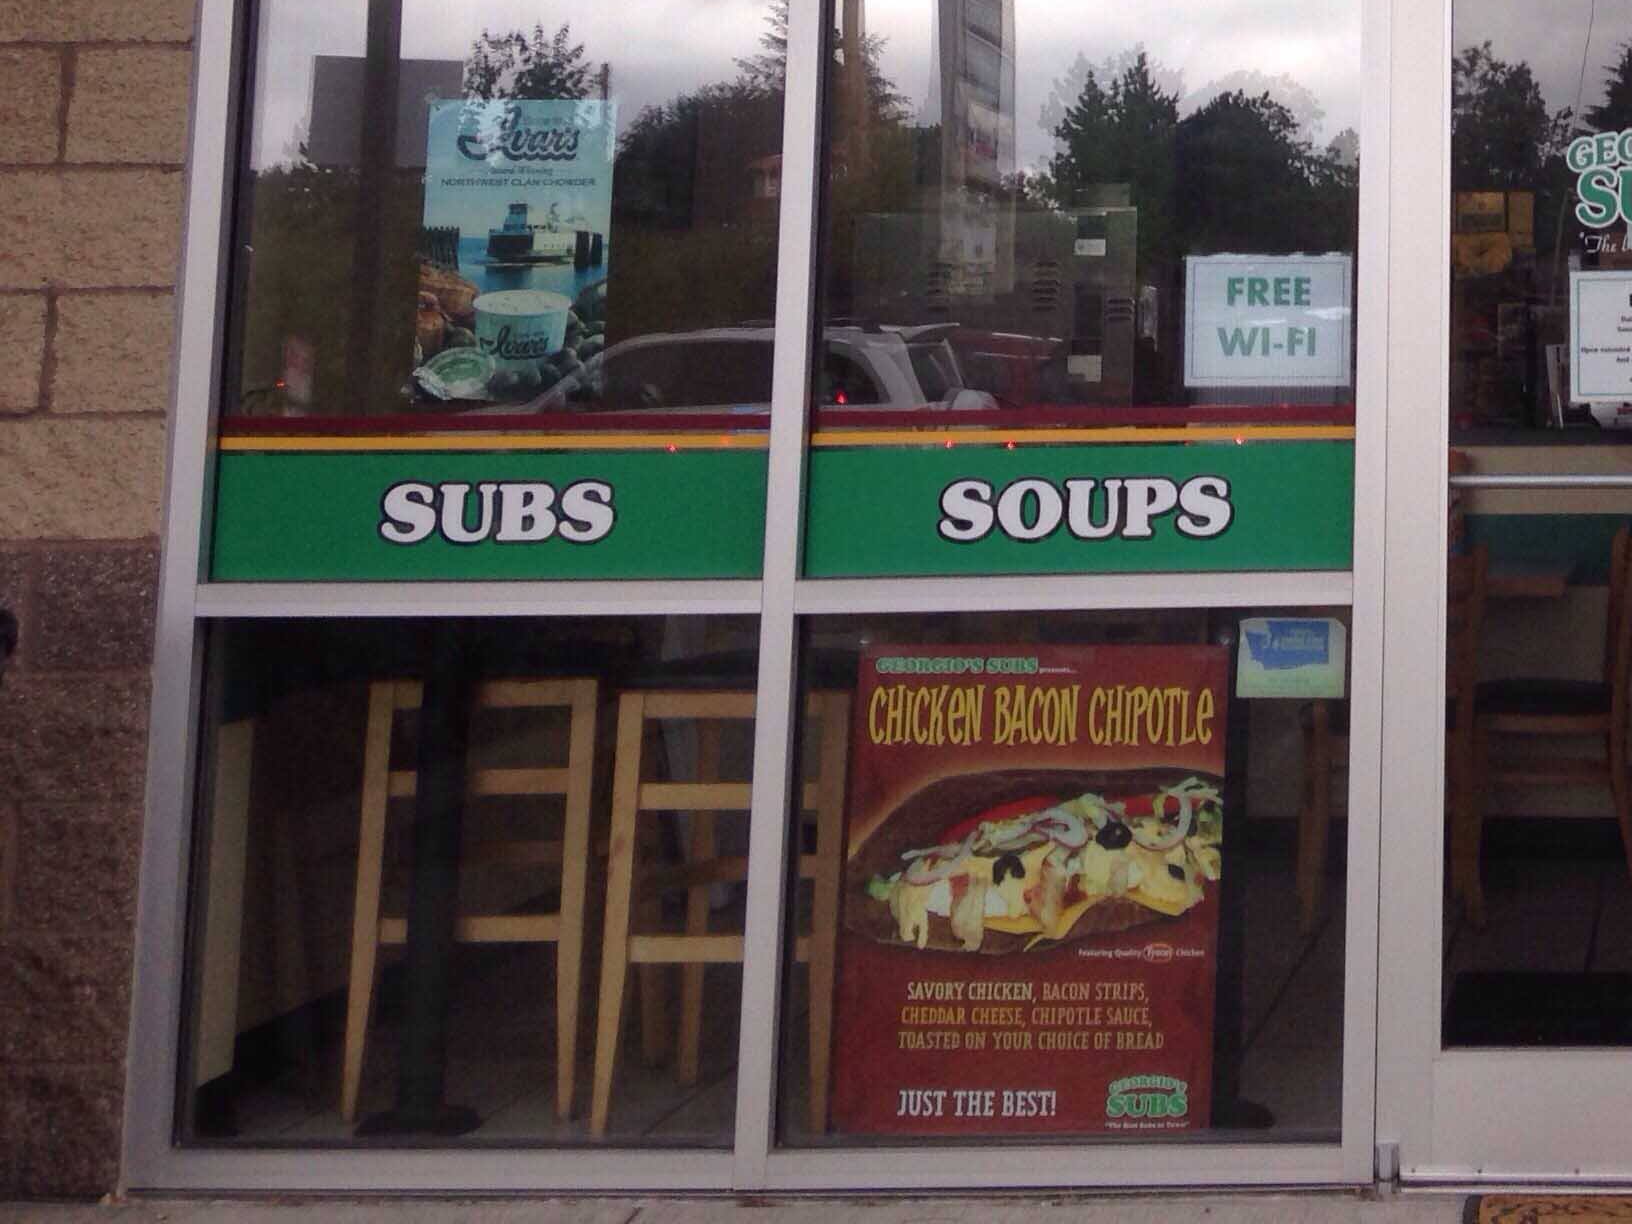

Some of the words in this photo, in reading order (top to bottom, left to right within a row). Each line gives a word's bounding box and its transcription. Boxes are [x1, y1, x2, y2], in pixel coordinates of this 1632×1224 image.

[1227, 277, 1311, 306] FREE
[1217, 327, 1316, 357] WI-FI
[381, 481, 615, 543] SUBS
[941, 479, 1233, 542] SOUPS
[876, 657, 984, 674] GEORGIO'S
[986, 657, 1038, 674] SUBS
[994, 684, 1081, 746] BACON
[907, 982, 965, 1001] SAVORY
[968, 982, 1036, 1003] CHICKEN,
[1043, 982, 1090, 1001] BACON
[1095, 982, 1149, 1004] STRIPS,
[901, 1007, 966, 1025] CHEDDAR
[971, 1007, 1026, 1027] CHEESE,
[1032, 1007, 1101, 1025] CHIPOTLE
[1106, 1007, 1152, 1028] SAUCE,
[898, 1031, 961, 1050] TOASTED
[965, 1031, 986, 1049] ON
[992, 1031, 1032, 1049] YOUR
[1038, 1031, 1088, 1049] CHOICE
[1094, 1031, 1112, 1049] OF
[1116, 1031, 1164, 1049] BREAD
[897, 1090, 947, 1117] JUST
[953, 1090, 995, 1116] THE
[1001, 1090, 1057, 1116] BEST!
[1105, 1092, 1188, 1118] SUBS
